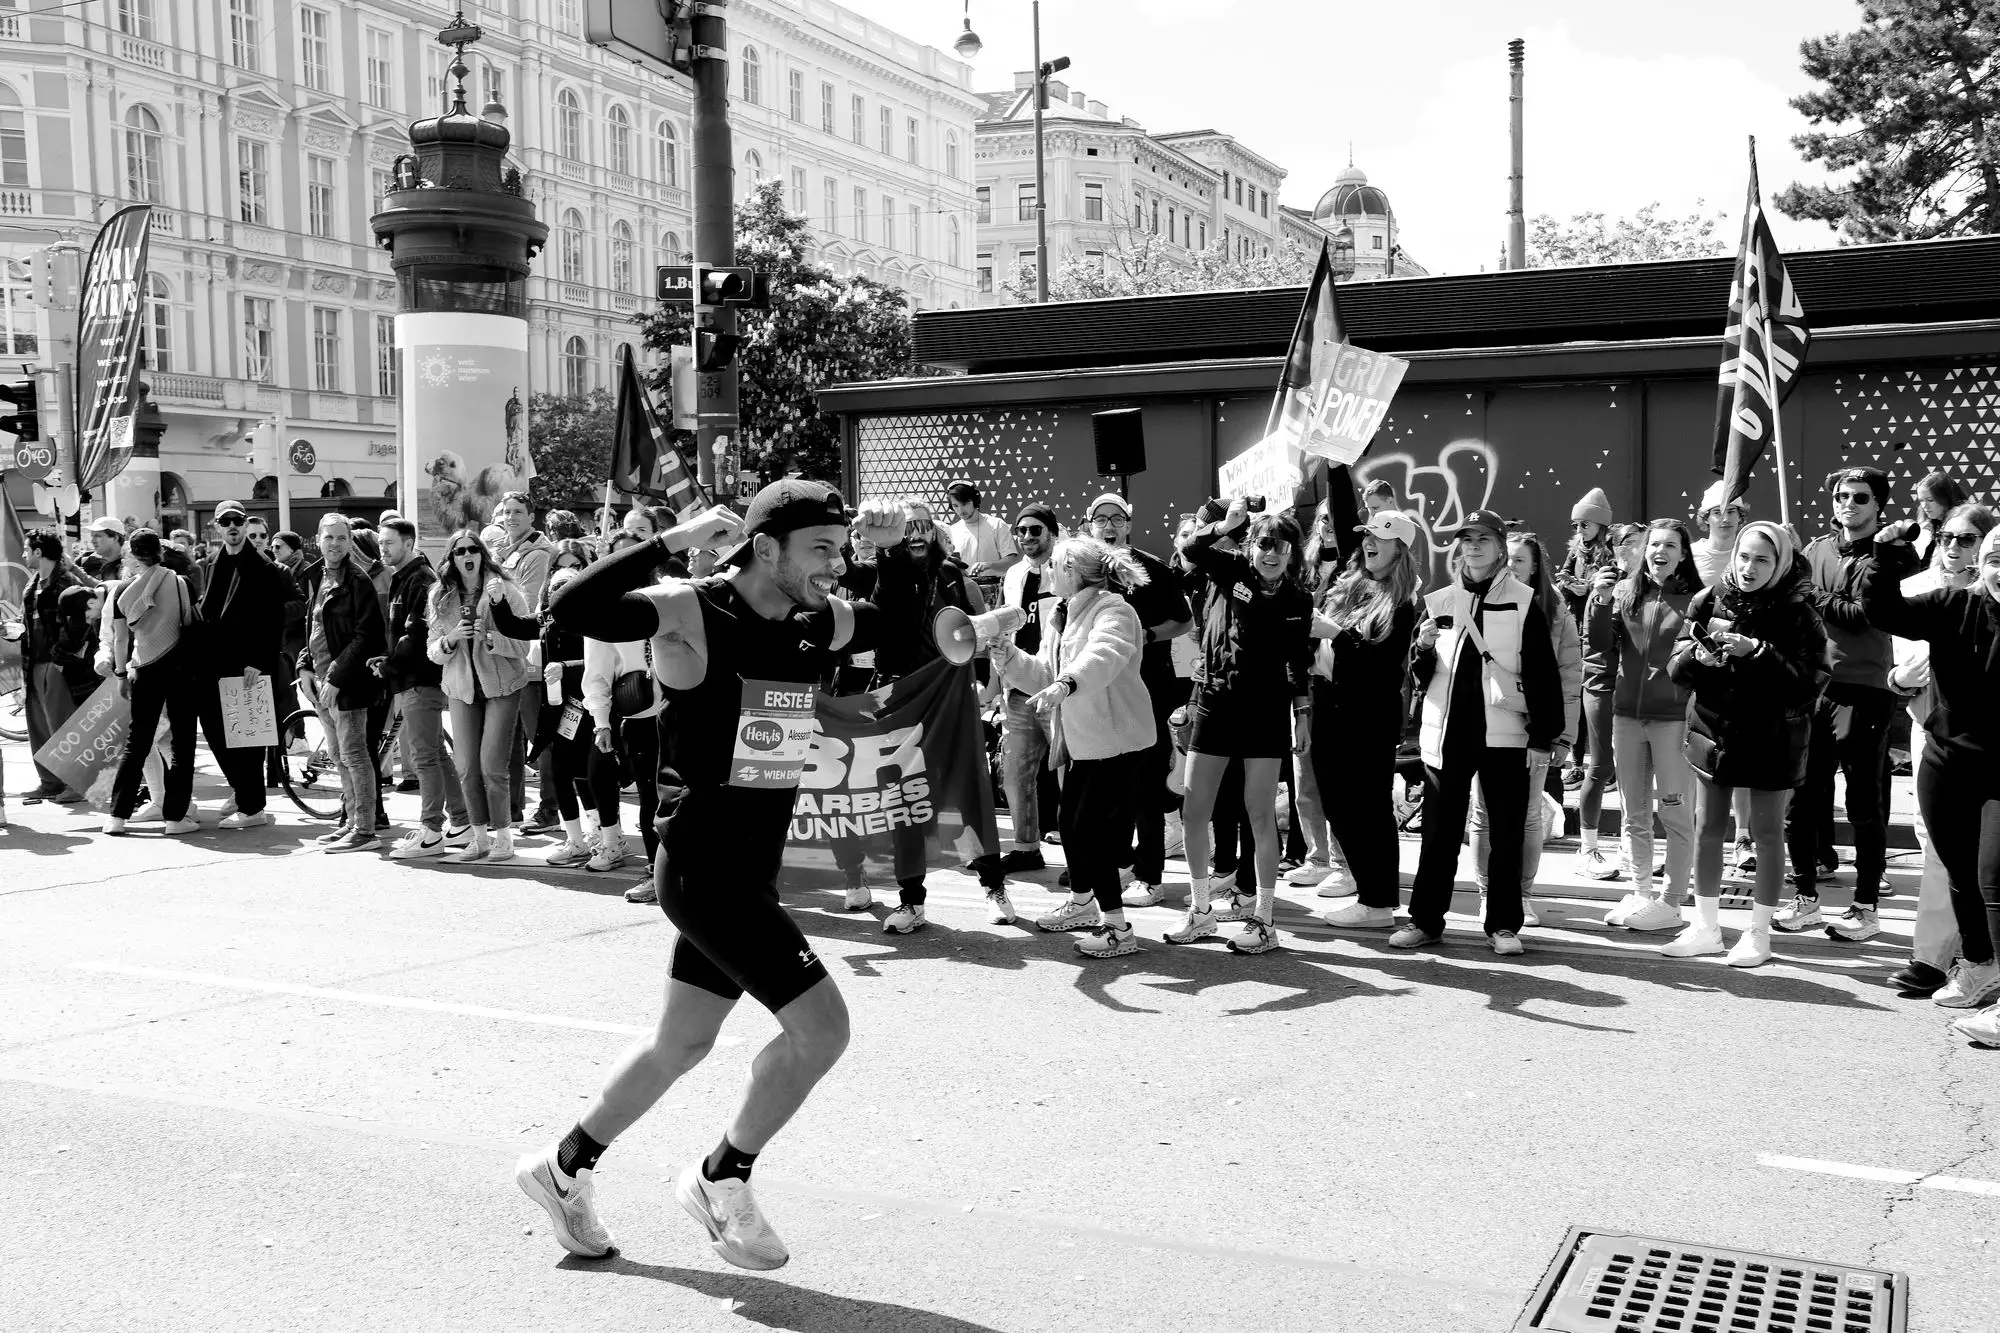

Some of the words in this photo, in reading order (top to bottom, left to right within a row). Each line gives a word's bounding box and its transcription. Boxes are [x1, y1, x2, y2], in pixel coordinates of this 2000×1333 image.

[48, 732, 80, 761] TOO
[79, 692, 113, 732] EARLY
[74, 749, 95, 767] TO
[93, 719, 122, 750] QUIT
[745, 726, 781, 745] Hervis
[763, 769, 786, 780] WIEN
[792, 777, 930, 815] ARBÈS
